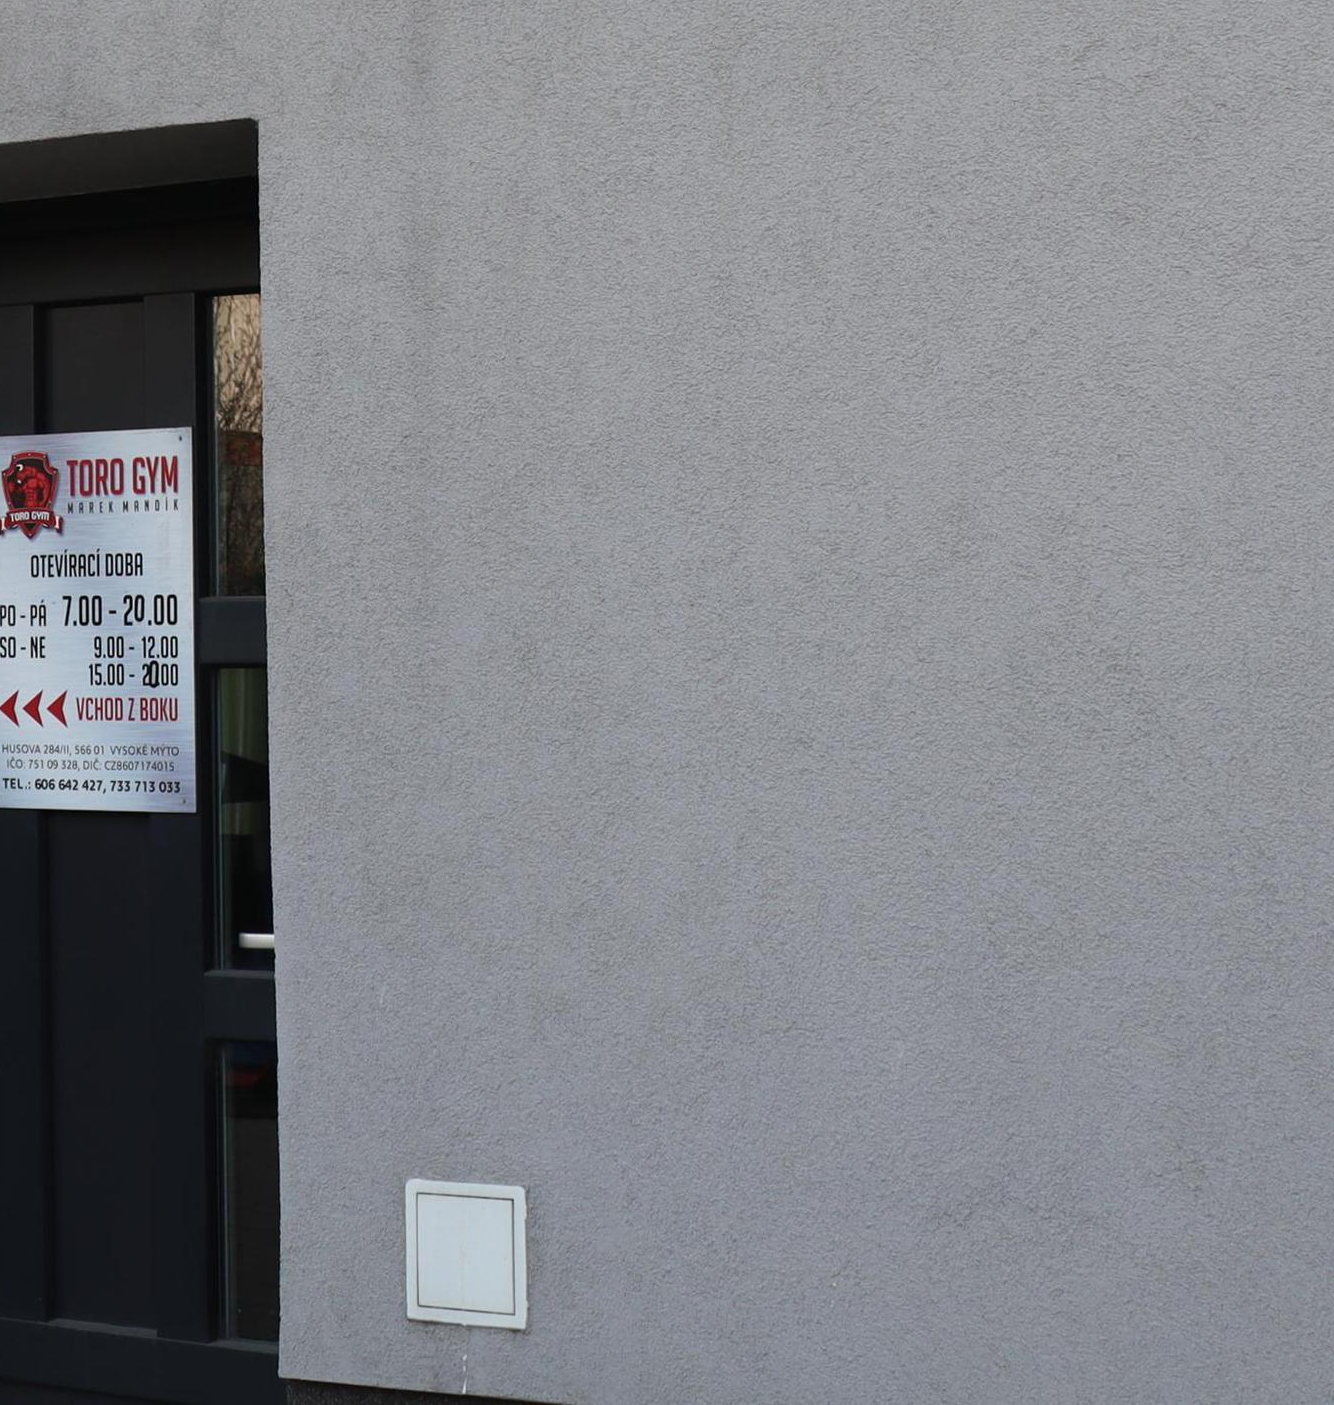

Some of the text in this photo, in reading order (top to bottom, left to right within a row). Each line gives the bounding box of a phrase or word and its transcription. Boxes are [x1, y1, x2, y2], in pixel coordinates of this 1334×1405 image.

[67, 455, 179, 497] TORO GYM
[11, 511, 50, 521] TORO GYM
[67, 504, 114, 514] MAREK
[31, 549, 143, 578] OTEVÍRACÍ DOBA
[0, 604, 16, 626] PO
[31, 600, 46, 626] PÁ
[62, 595, 102, 626] 7.00
[123, 594, 178, 626] 20.00
[0, 637, 16, 658] SO
[31, 636, 46, 658] NE
[94, 636, 124, 658] 9.00
[142, 636, 178, 658] 12.00
[89, 663, 124, 686] 15.00
[76, 698, 178, 721] VCHOD Z BOKU
[2, 745, 41, 754] HUSOVA
[75, 746, 92, 755] 566
[93, 746, 104, 755] 01
[110, 745, 147, 756] VYSOKÉ
[151, 744, 179, 756] MÝTO
[6, 758, 175, 771] IČO: 751 09 328, DIČ: CZ8607174015
[3, 778, 180, 794] TEL.: 606 642 427, 733 713 033
